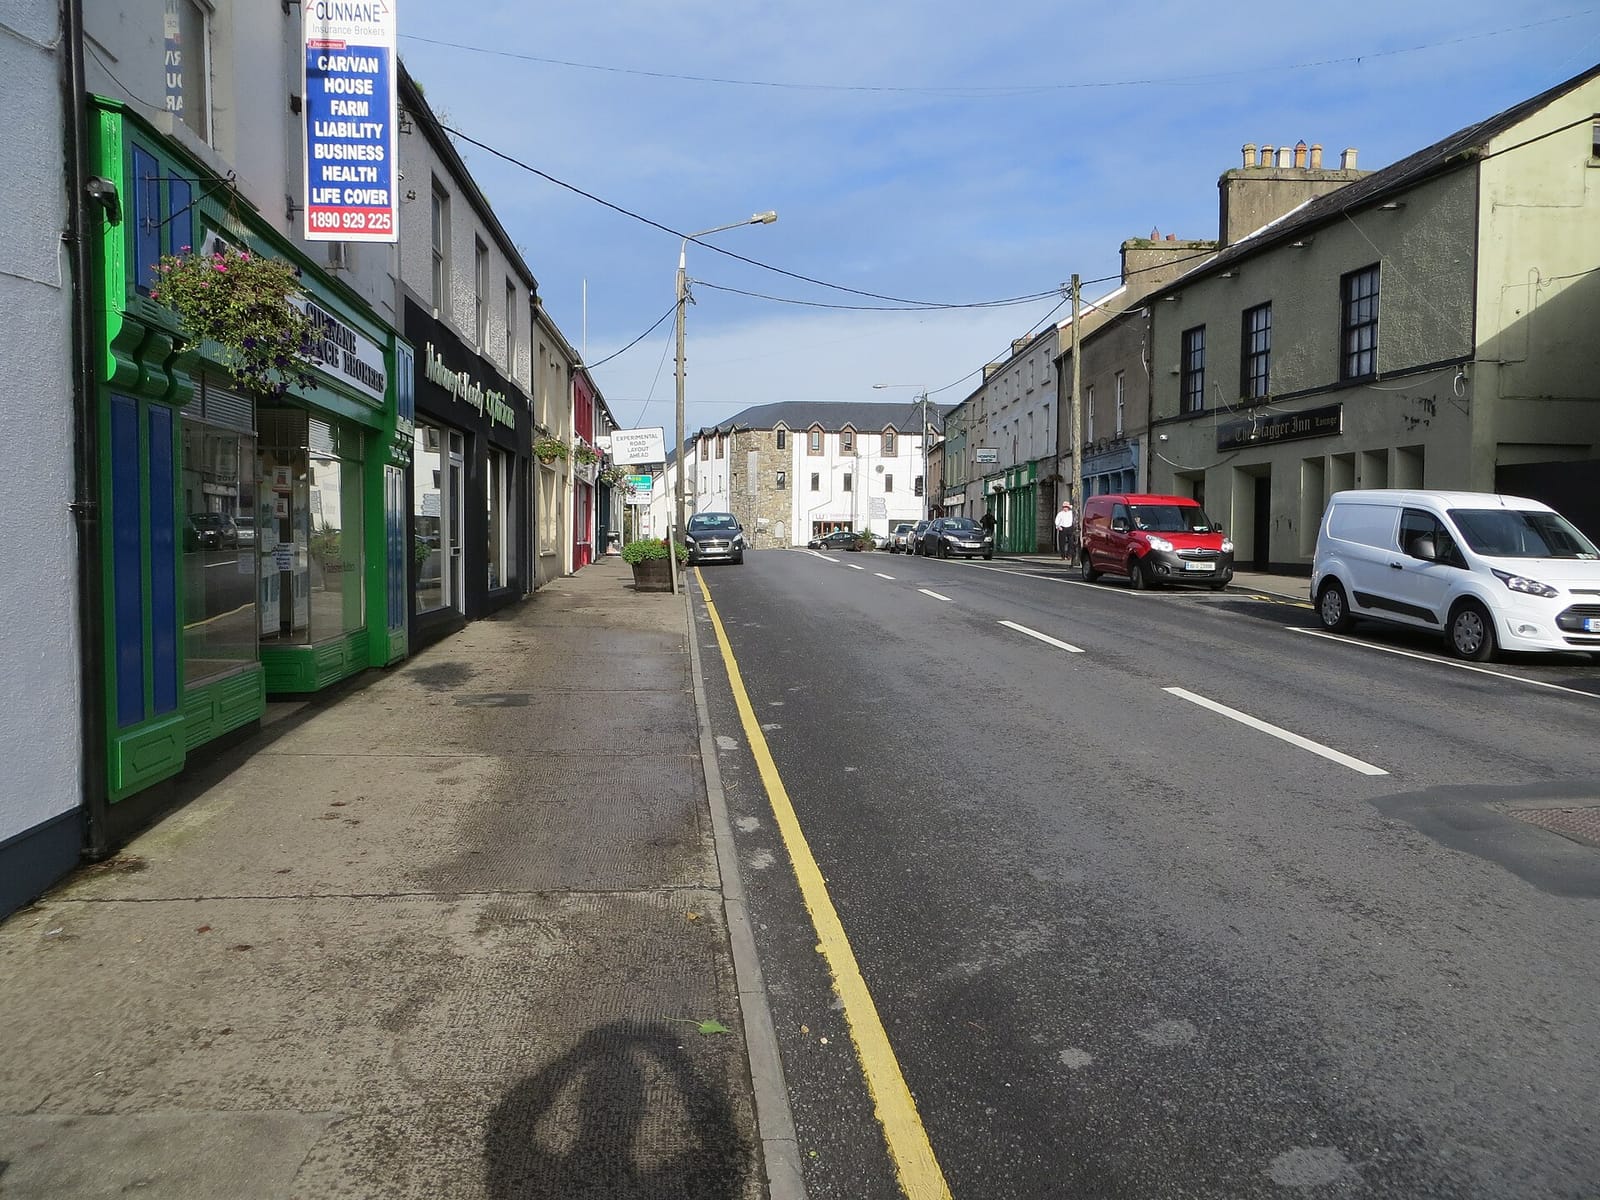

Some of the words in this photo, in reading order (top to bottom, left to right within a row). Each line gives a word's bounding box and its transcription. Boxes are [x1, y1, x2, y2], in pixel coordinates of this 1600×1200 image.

[316, 2, 381, 22] CUNNANE
[312, 23, 352, 35] Insurance
[354, 26, 385, 36] Brokers
[317, 55, 379, 73] CAR/VAN
[324, 77, 373, 95] HOUSE
[330, 99, 369, 117] FARM
[314, 121, 383, 139] LIABILITY
[314, 143, 384, 161] BUSINESS
[322, 165, 377, 182] HEALTH
[312, 187, 341, 204] LIFE
[343, 188, 388, 205] COVER
[310, 211, 340, 228] 1890
[342, 212, 366, 229] 929
[367, 213, 391, 230] 225
[1291, 415, 1311, 433] Inn
[616, 433, 658, 441] EXPERIMENTAL
